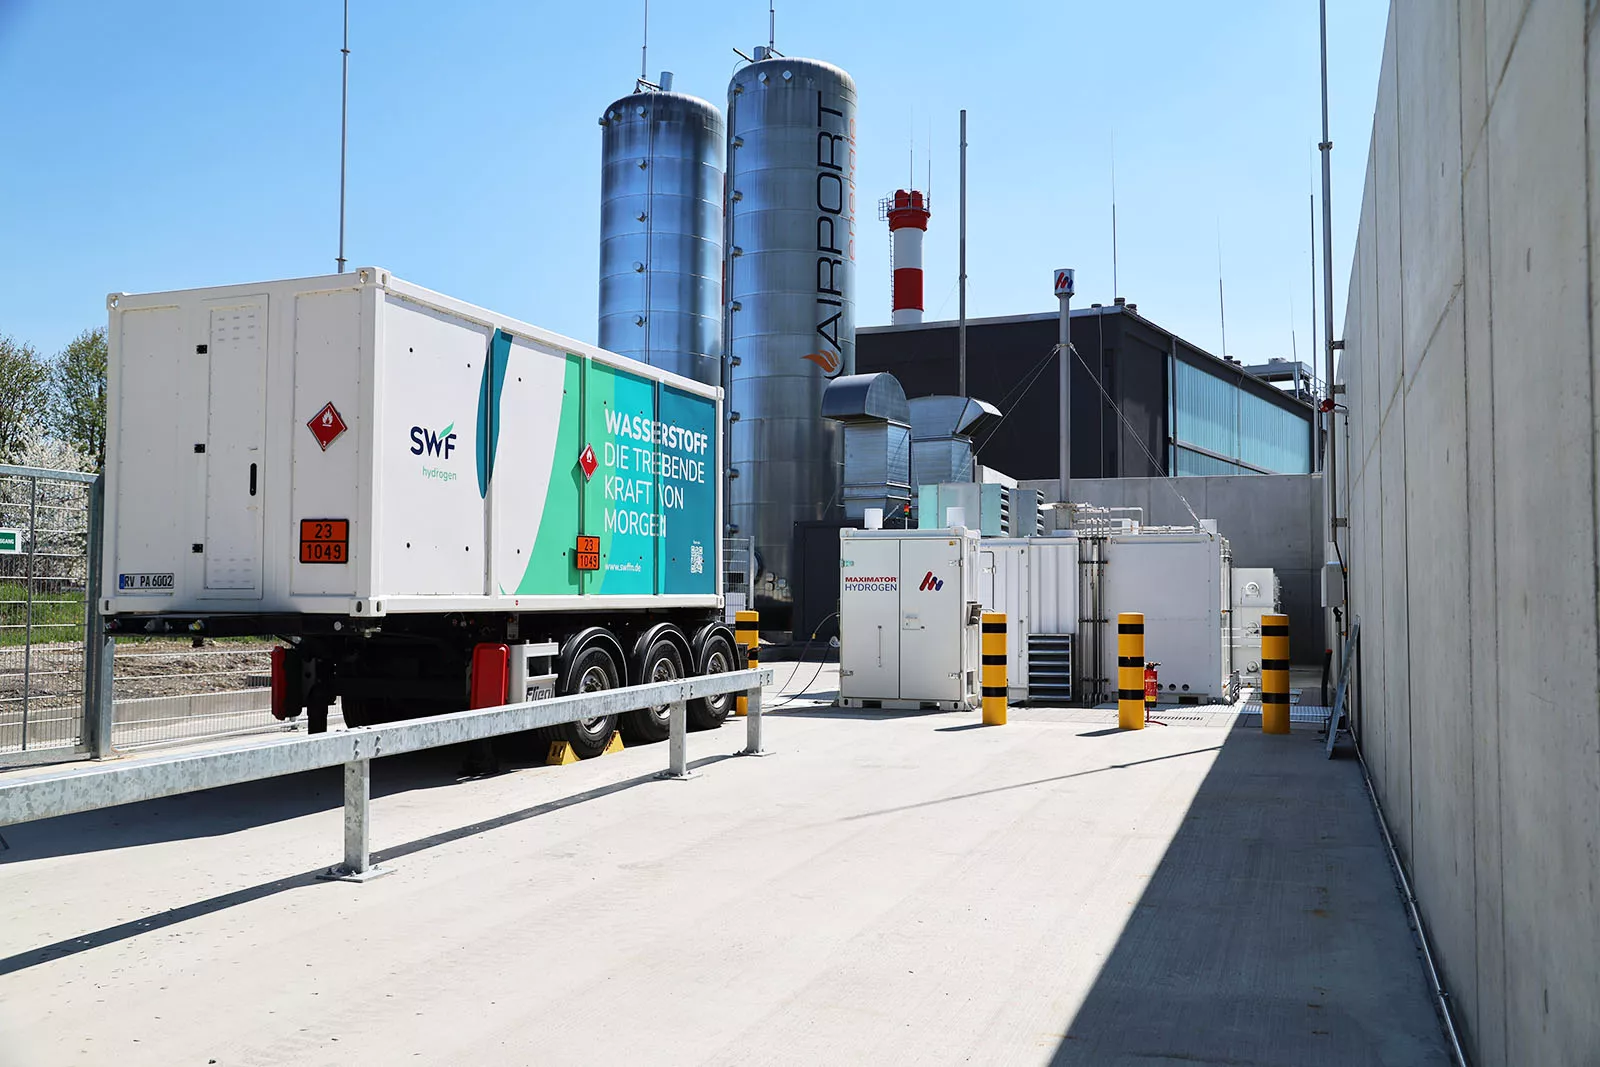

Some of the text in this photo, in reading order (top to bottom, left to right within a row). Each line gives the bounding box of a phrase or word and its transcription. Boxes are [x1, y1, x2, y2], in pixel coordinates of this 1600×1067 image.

[816, 90, 843, 353] AIRPORT
[604, 408, 708, 456] WASSERSTOFF
[410, 425, 457, 460] SWF
[604, 442, 629, 469] DIE
[422, 465, 457, 482] hydrogen
[604, 474, 652, 504] KRAFT
[314, 523, 333, 539] 23
[604, 507, 667, 538] MORGEN
[306, 544, 342, 560] 1049
[584, 538, 594, 551] 23
[580, 554, 597, 568] 1049
[124, 575, 136, 588] RV
[140, 575, 151, 587] PA
[844, 583, 898, 592] HYDROGEN
